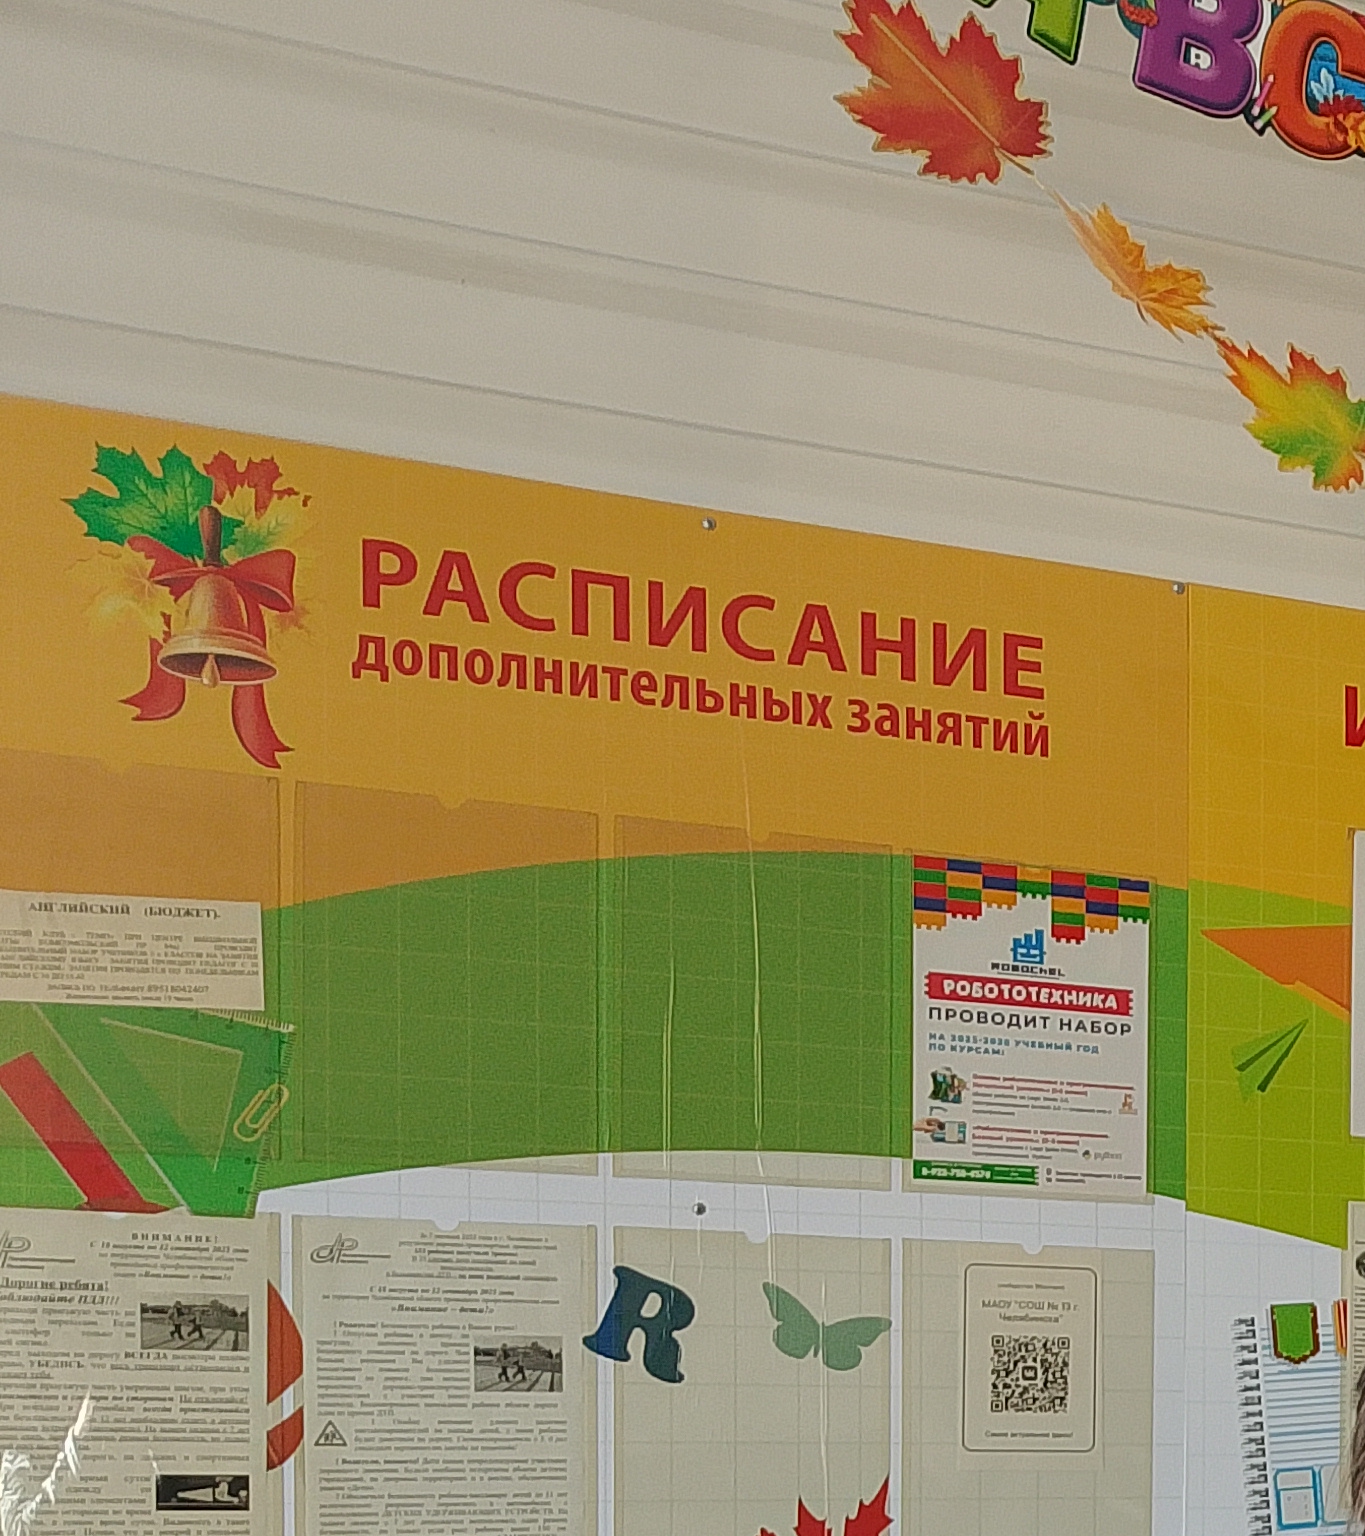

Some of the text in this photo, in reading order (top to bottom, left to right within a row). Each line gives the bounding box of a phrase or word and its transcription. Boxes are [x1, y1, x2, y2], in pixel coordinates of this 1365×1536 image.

[360, 536, 1047, 701] РАСПИСАНИЕ
[350, 634, 1052, 759] дополнительных занятий
[28, 901, 131, 915] АНГЛИЙСКИЙ
[942, 979, 1119, 1011] РОБОТОТЕХНИКА
[928, 1006, 1132, 1037] ПРОВОДИТ НАБОР
